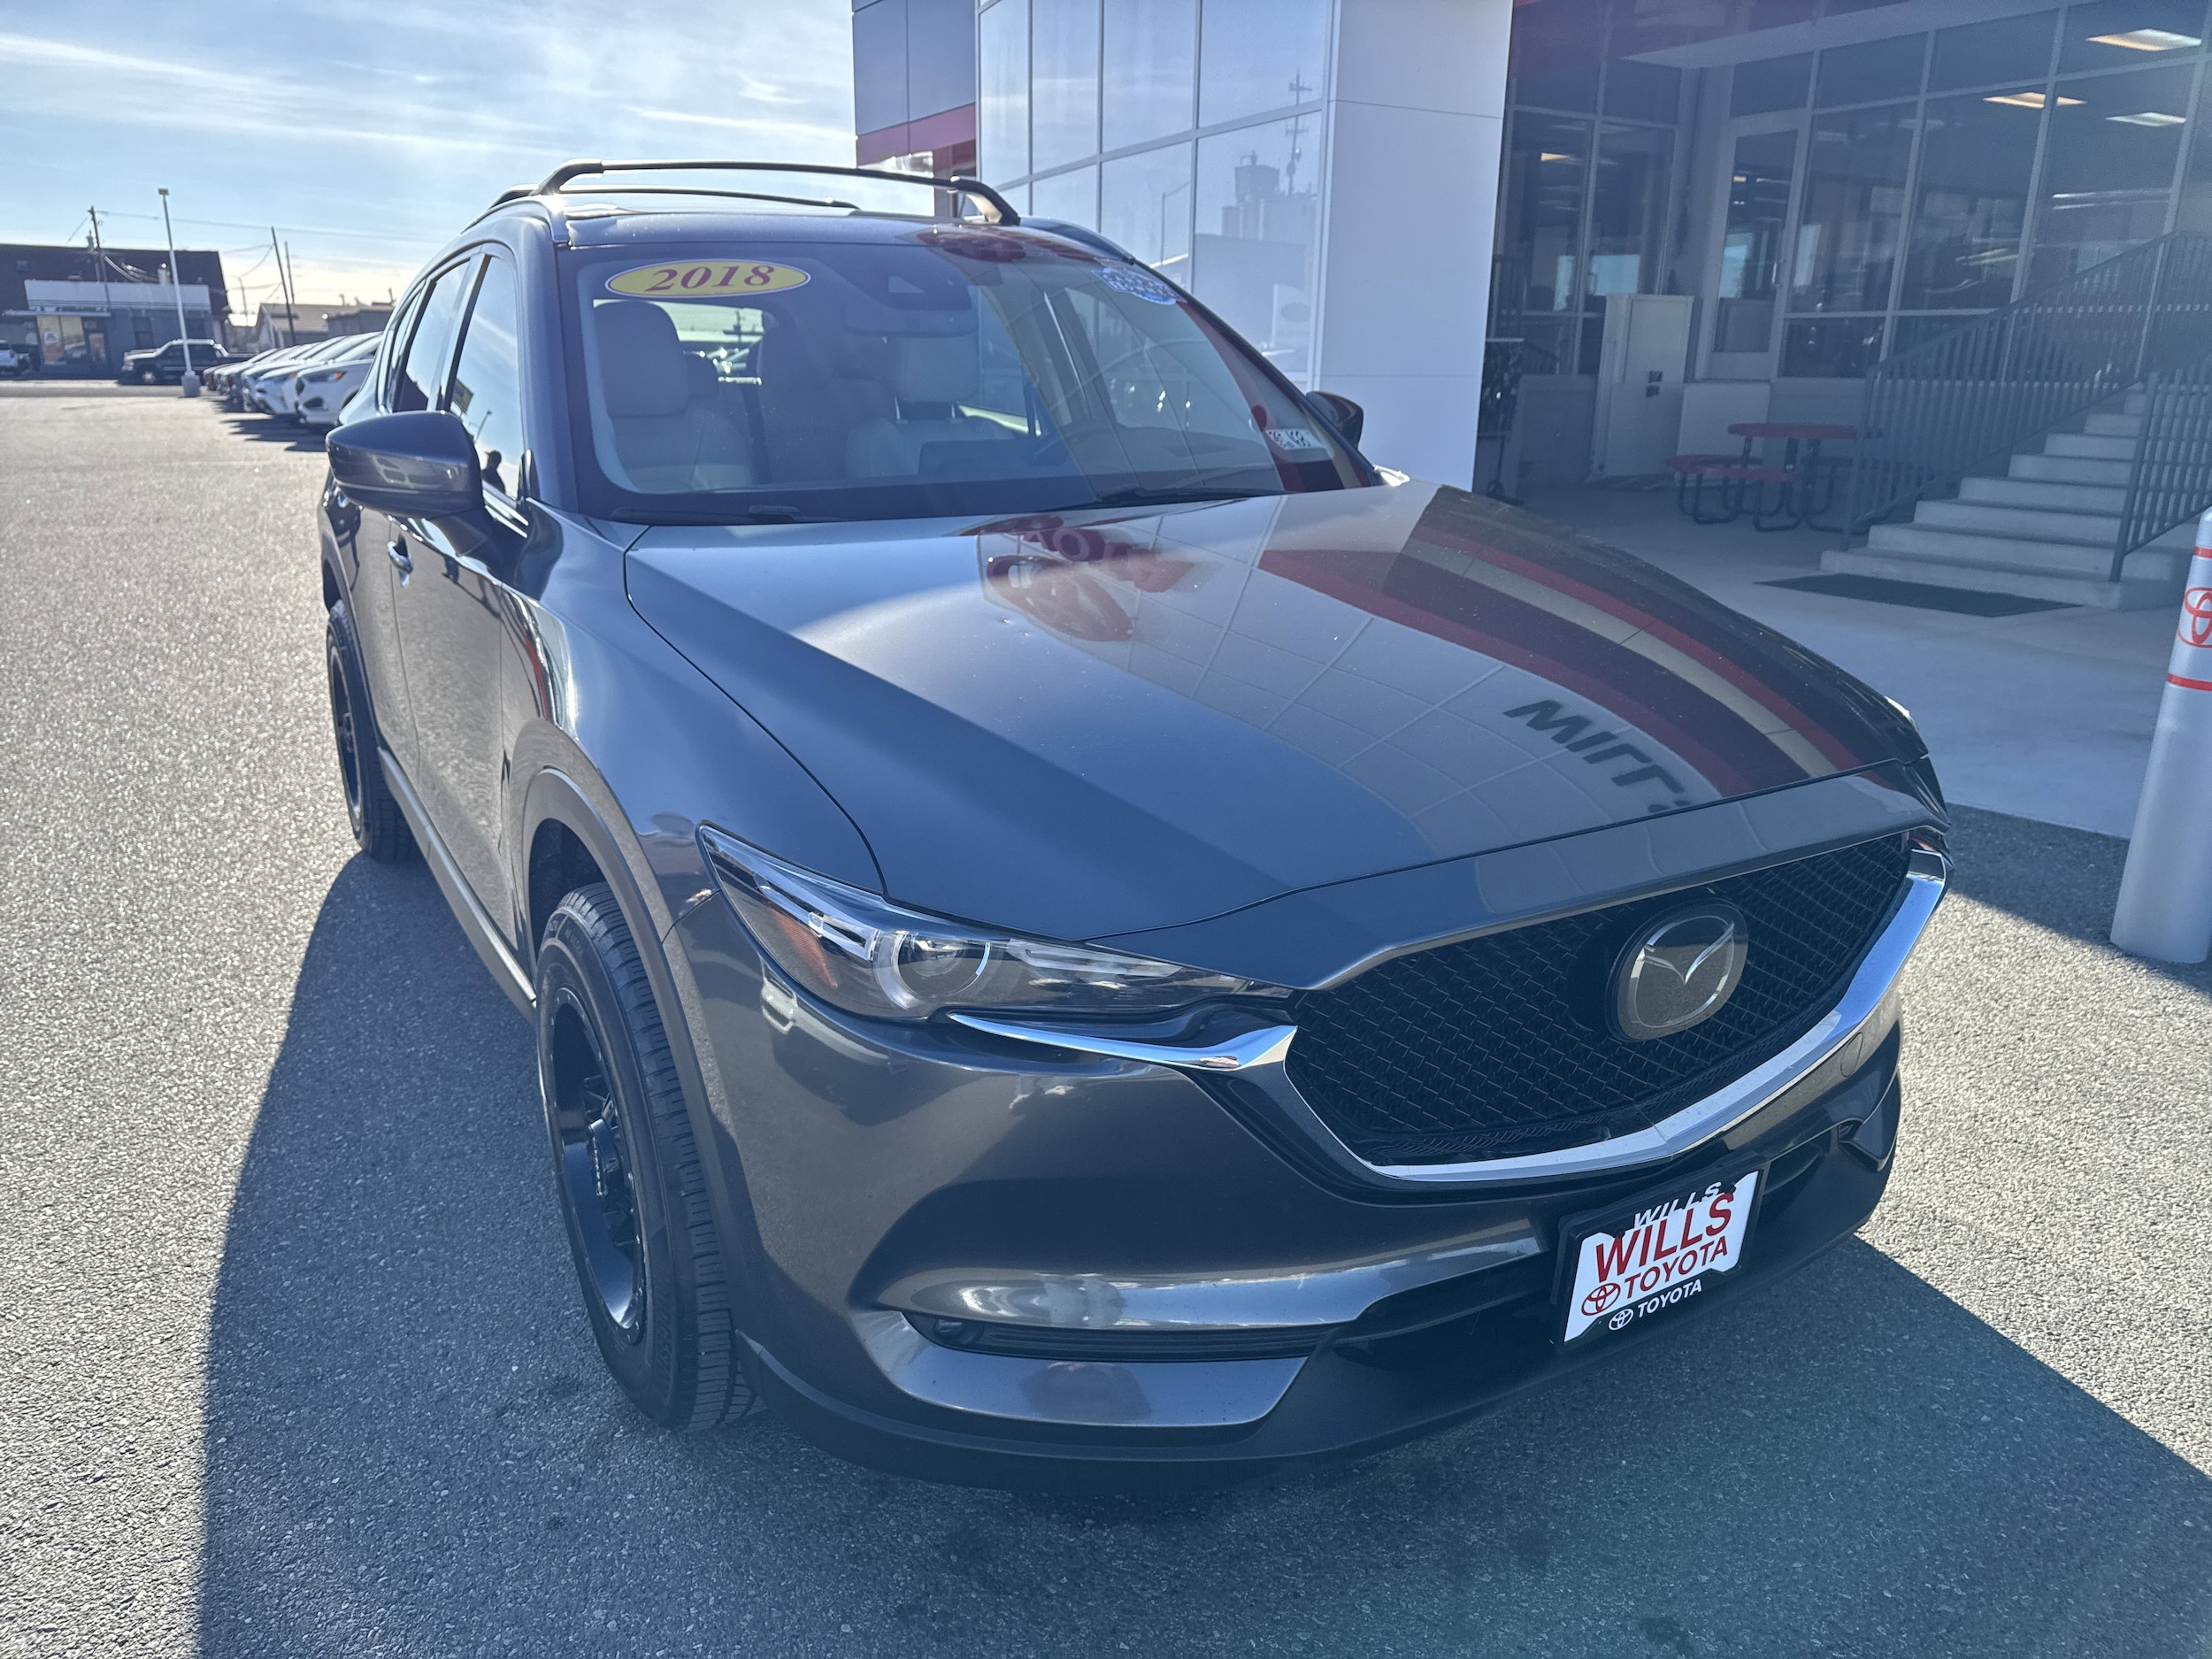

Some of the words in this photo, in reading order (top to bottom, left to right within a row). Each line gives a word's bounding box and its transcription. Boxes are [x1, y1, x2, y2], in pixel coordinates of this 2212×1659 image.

[645, 265, 774, 292] 2018
[1596, 1193, 1734, 1283] WILLS
[1624, 1236, 1728, 1300] TOYOTA
[1638, 1279, 1702, 1318] TOYOTA
